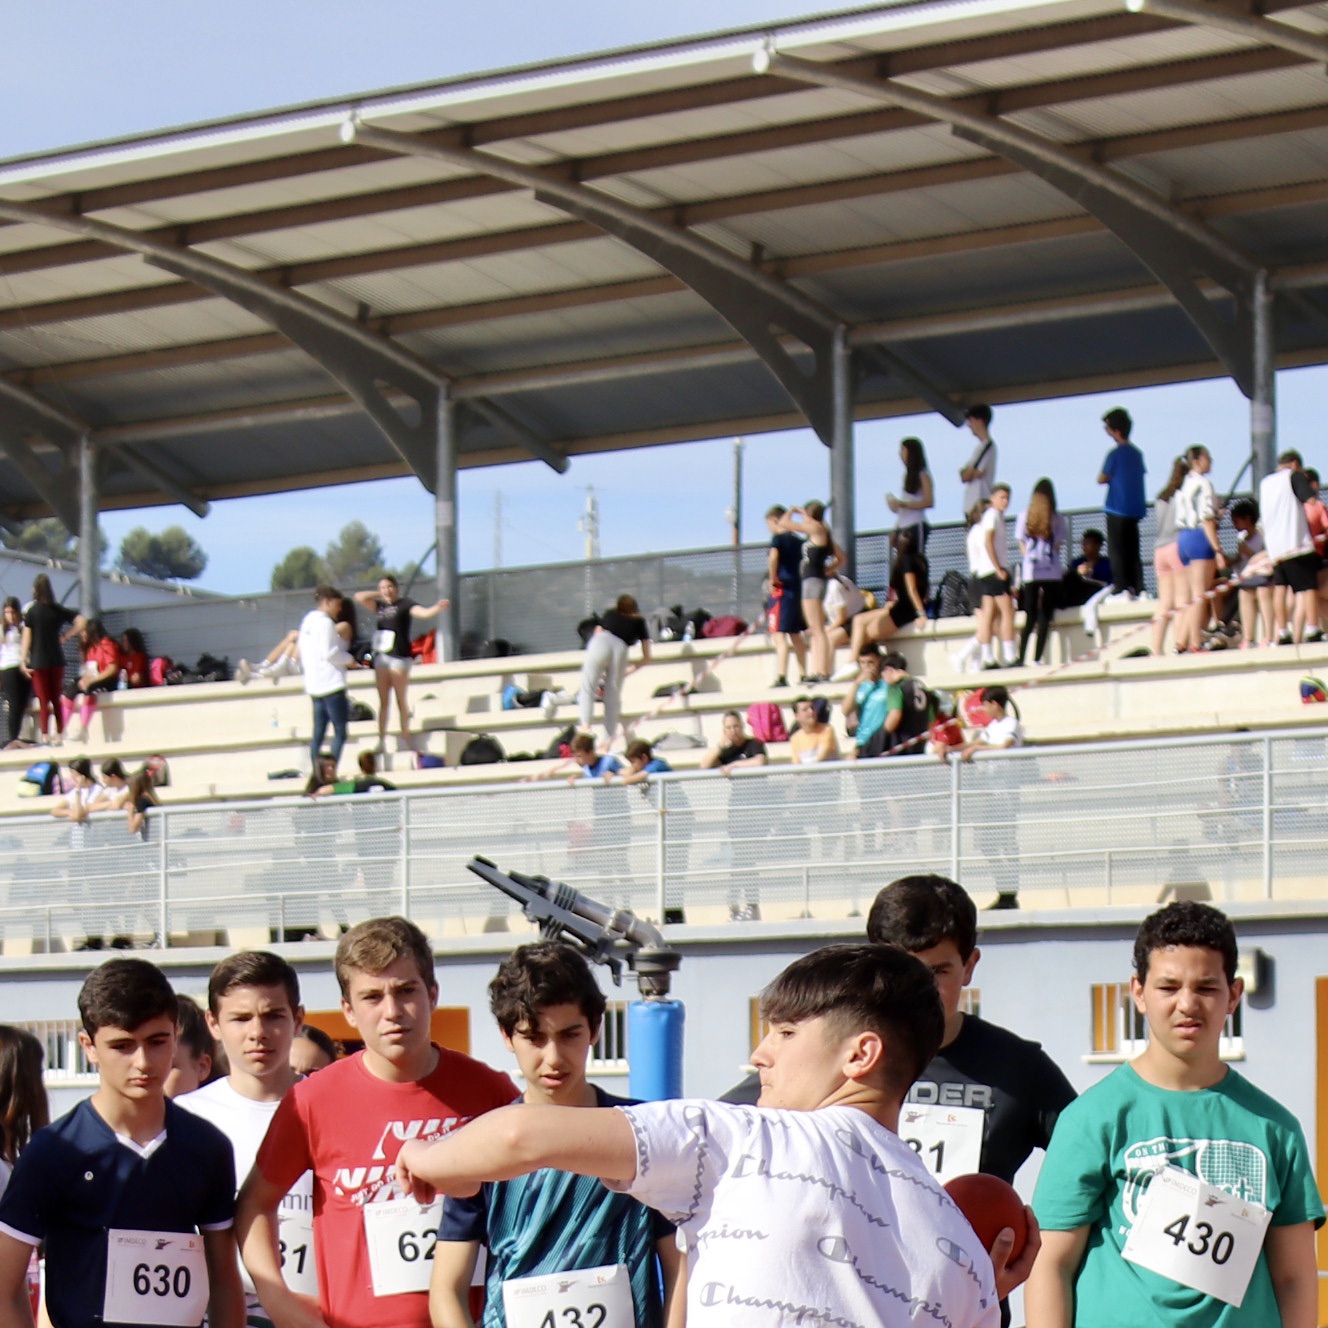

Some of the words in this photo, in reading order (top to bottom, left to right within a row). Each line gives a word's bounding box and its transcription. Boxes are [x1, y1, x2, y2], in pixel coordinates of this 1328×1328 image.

[904, 1080, 993, 1108] DER
[1163, 1214, 1235, 1266] 430
[133, 1263, 192, 1298] 630
